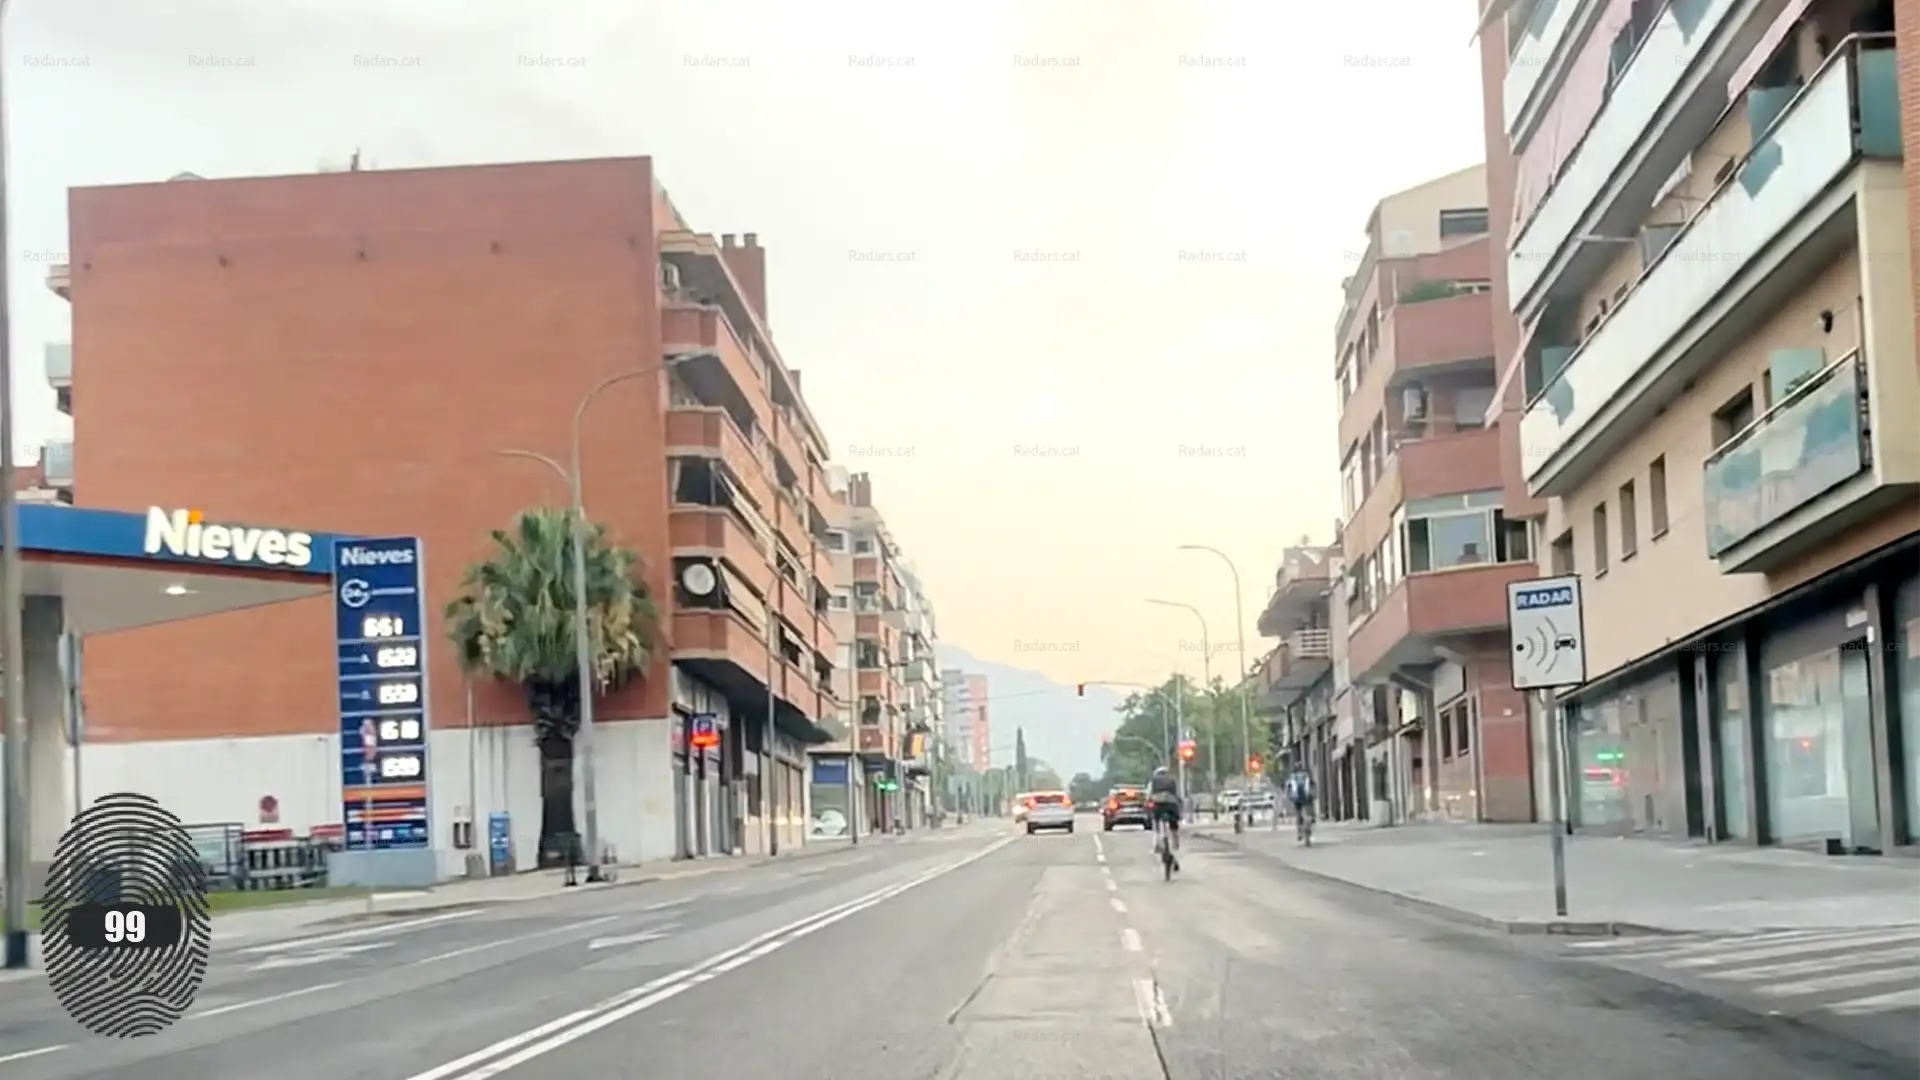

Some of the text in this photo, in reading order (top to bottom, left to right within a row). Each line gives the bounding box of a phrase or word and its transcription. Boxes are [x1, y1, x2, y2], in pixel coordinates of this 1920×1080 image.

[144, 506, 312, 567] Nieves
[341, 546, 414, 567] Nieves
[1516, 589, 1572, 607] RADAR
